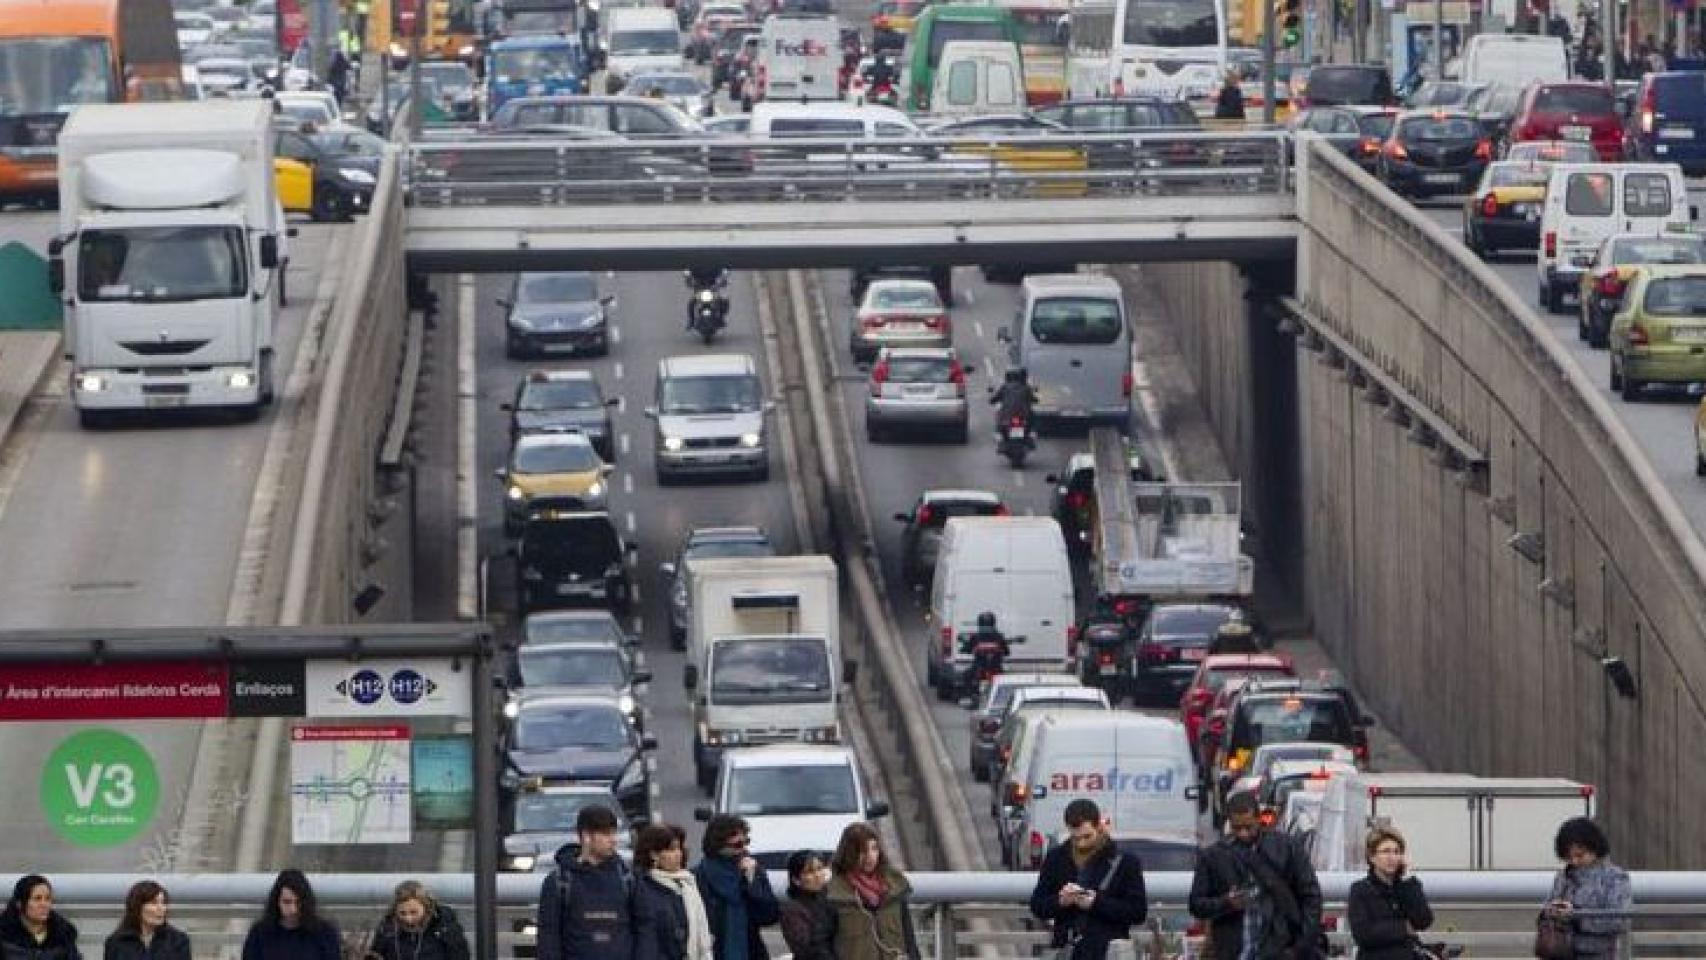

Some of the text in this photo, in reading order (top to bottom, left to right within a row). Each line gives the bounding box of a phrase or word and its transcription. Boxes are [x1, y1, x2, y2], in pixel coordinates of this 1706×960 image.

[775, 39, 828, 57] FedEx
[41, 682, 120, 698] d'intercanvi
[179, 682, 221, 698] Cerdà
[235, 681, 293, 697] Enllaços
[352, 679, 423, 694] H12 H12
[64, 763, 136, 808] V3
[1051, 767, 1174, 794] arafred
